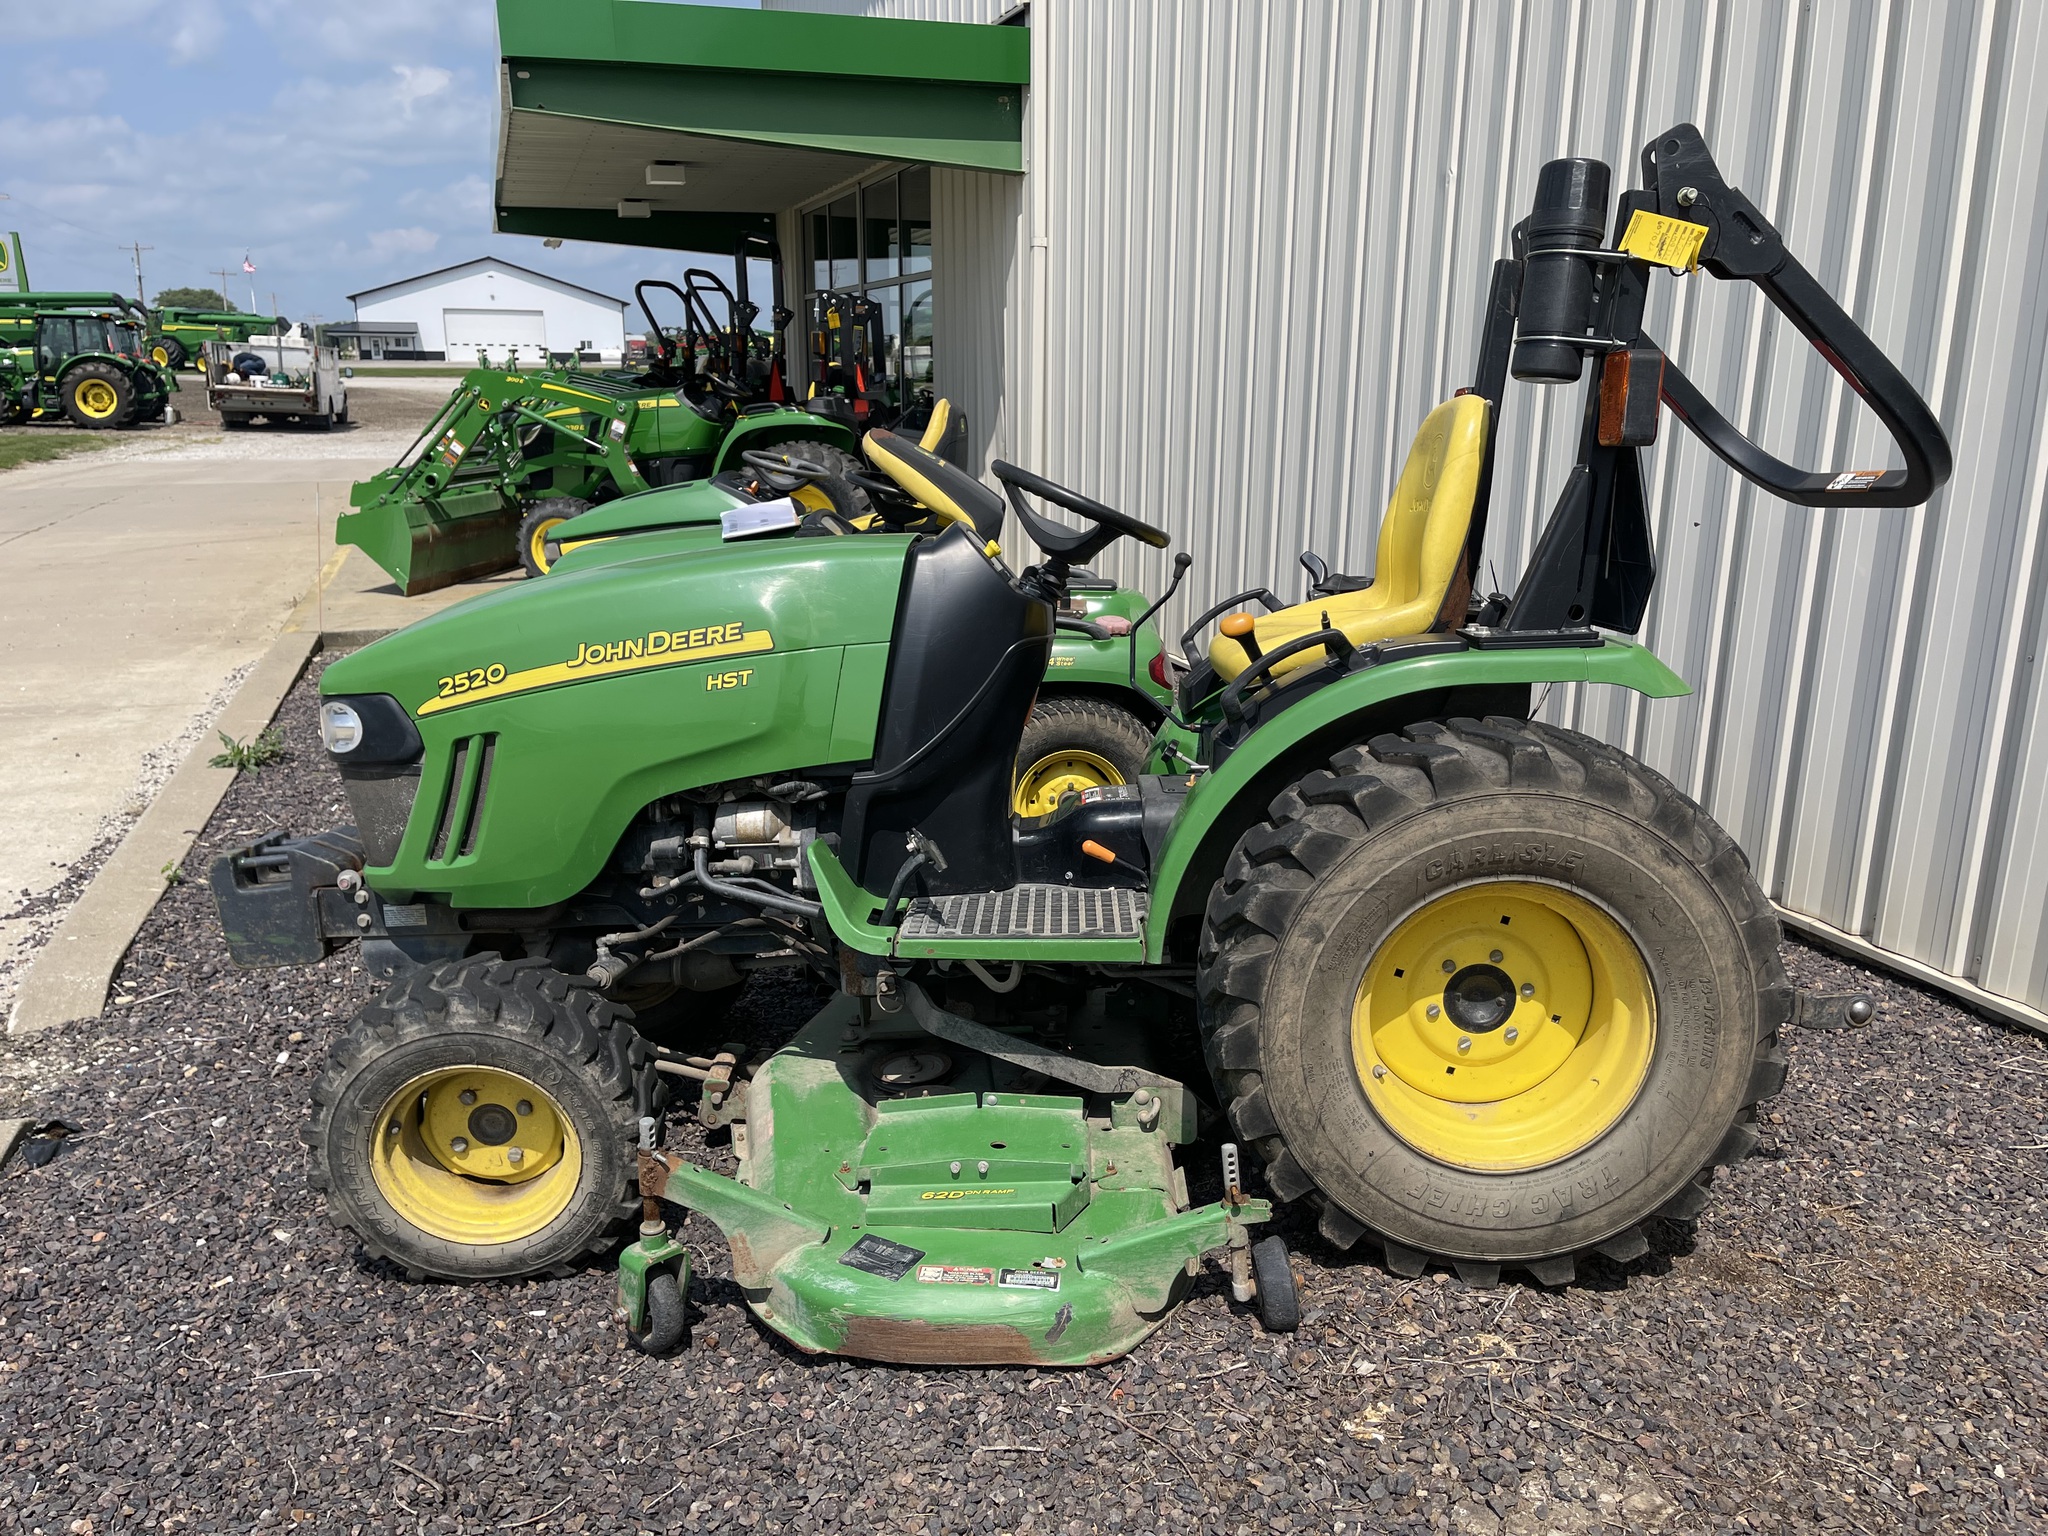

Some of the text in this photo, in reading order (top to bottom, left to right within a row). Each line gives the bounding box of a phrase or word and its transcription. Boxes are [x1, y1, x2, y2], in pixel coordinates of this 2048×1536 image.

[566, 620, 744, 669] JOHN DEERE
[437, 661, 508, 699] 2520
[705, 668, 754, 692] HST
[1424, 842, 1585, 883] CARLISLE
[920, 1190, 966, 1201] 62D
[1407, 1180, 1512, 1219] CHIEF
[1532, 1165, 1620, 1215] TRAC
